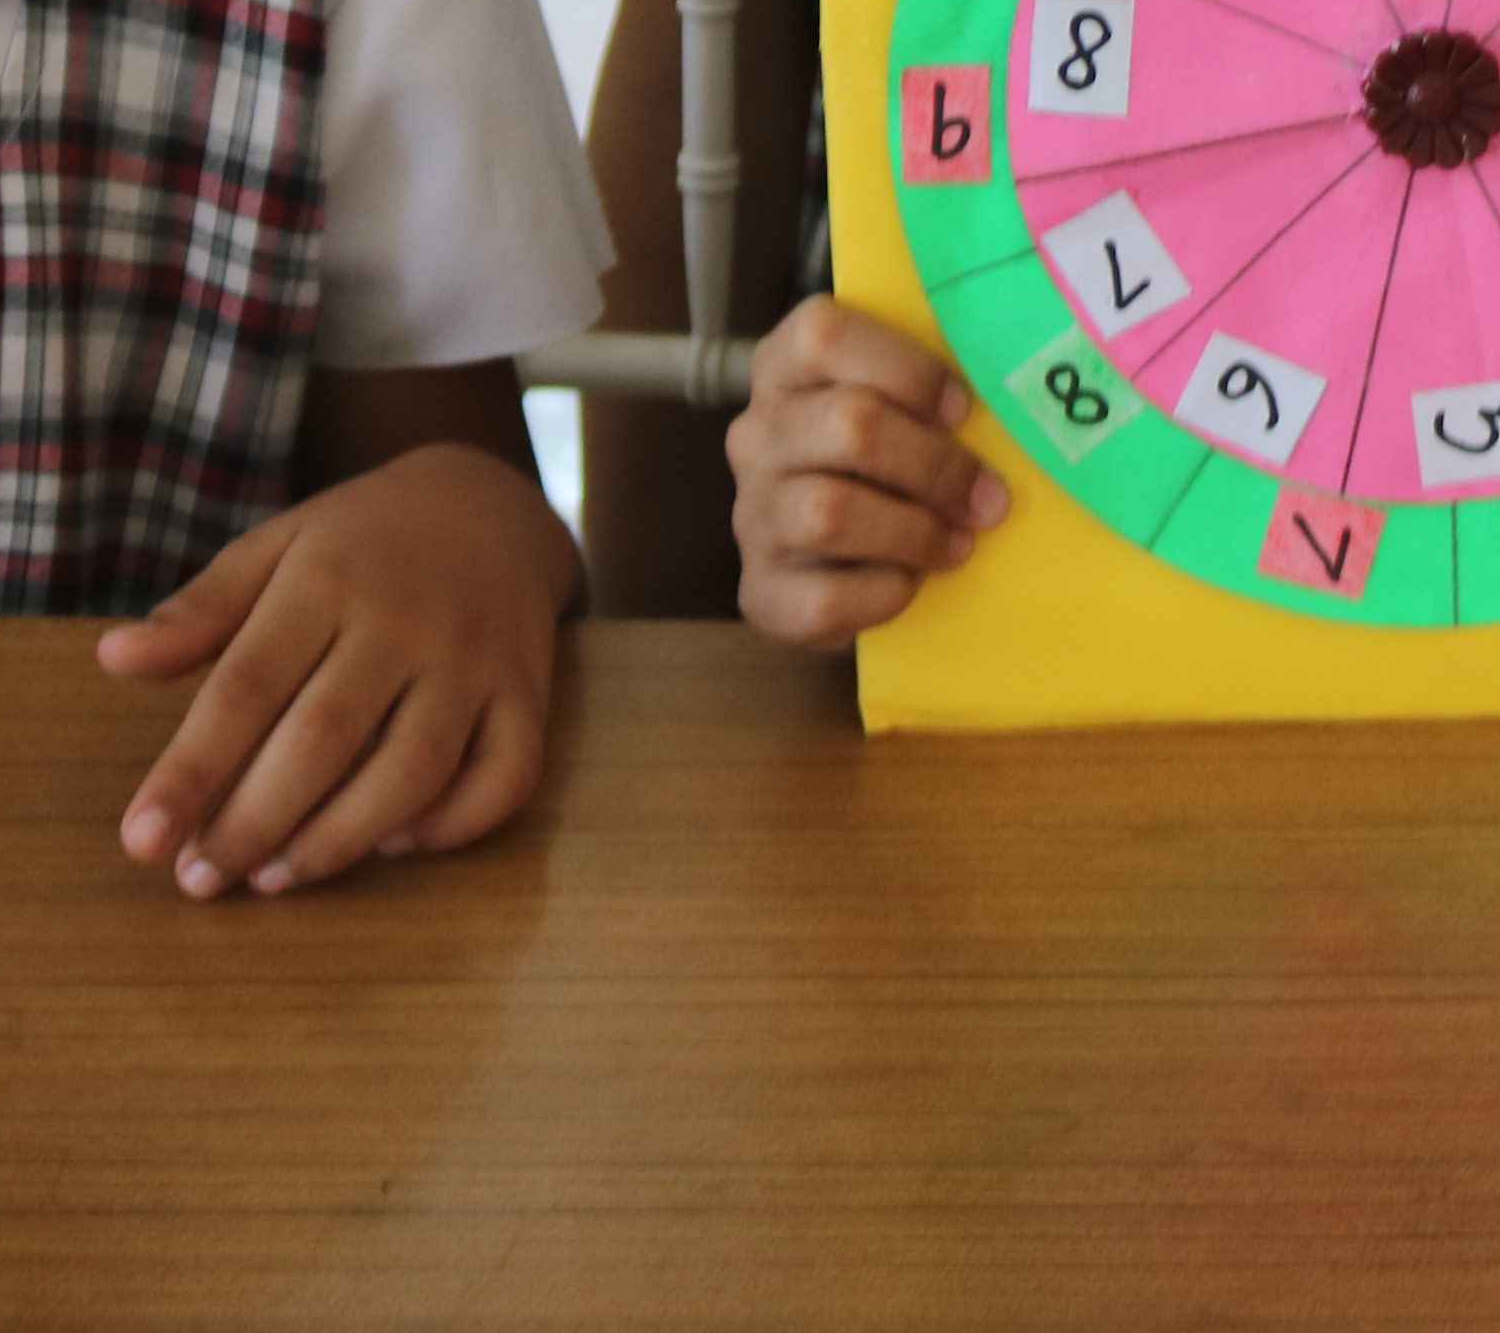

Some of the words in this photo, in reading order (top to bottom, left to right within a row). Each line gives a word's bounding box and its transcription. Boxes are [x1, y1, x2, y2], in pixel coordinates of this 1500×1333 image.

[1056, 11, 1113, 92] 8
[930, 79, 972, 161] 9
[1104, 241, 1151, 311] 7
[1044, 363, 1110, 426] 8
[1216, 362, 1280, 431] 6
[1292, 510, 1352, 583] 7
